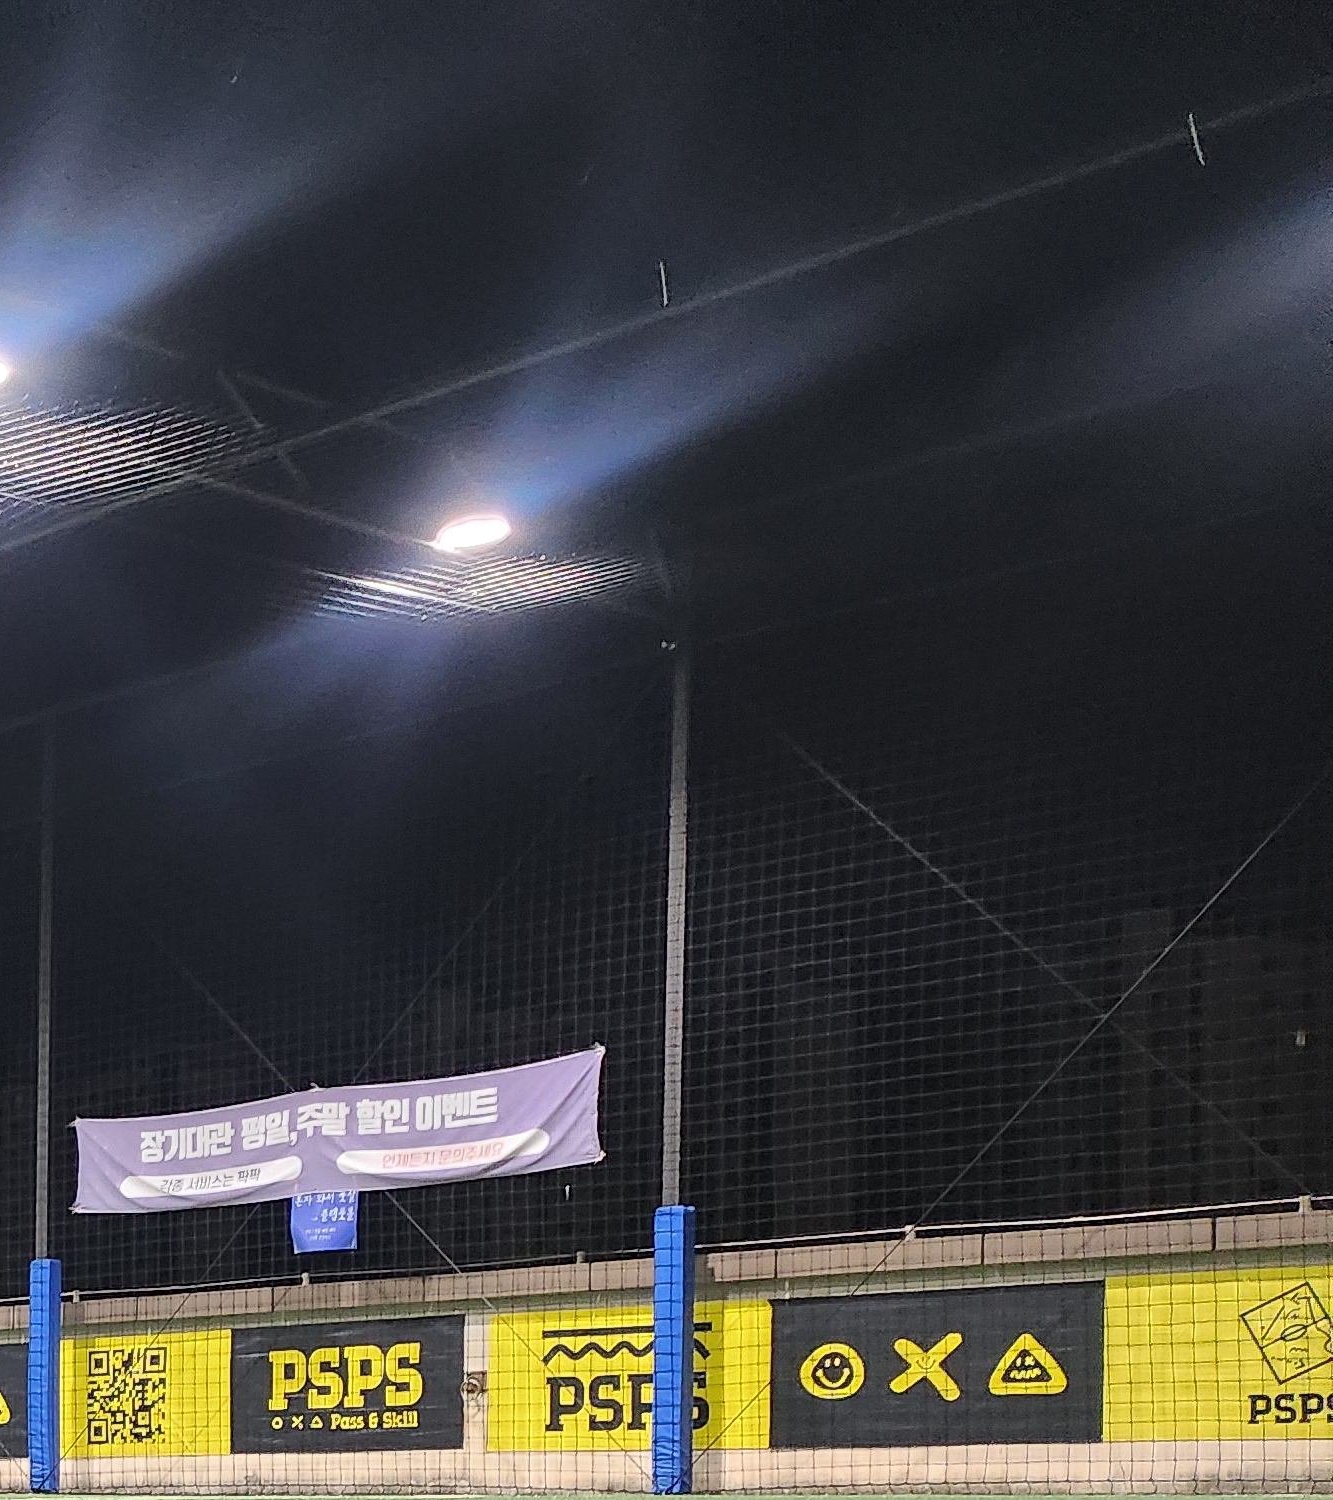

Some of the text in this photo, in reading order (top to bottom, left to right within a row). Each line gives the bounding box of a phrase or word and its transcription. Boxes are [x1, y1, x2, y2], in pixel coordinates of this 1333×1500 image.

[140, 1122, 235, 1163] 장기대관
[356, 1097, 410, 1135] 할인
[415, 1087, 498, 1131] 이벤트
[186, 1173, 234, 1190] 서비스는
[268, 1342, 423, 1411] PSPS
[330, 1413, 365, 1431] Pass
[382, 1410, 419, 1429] Skill
